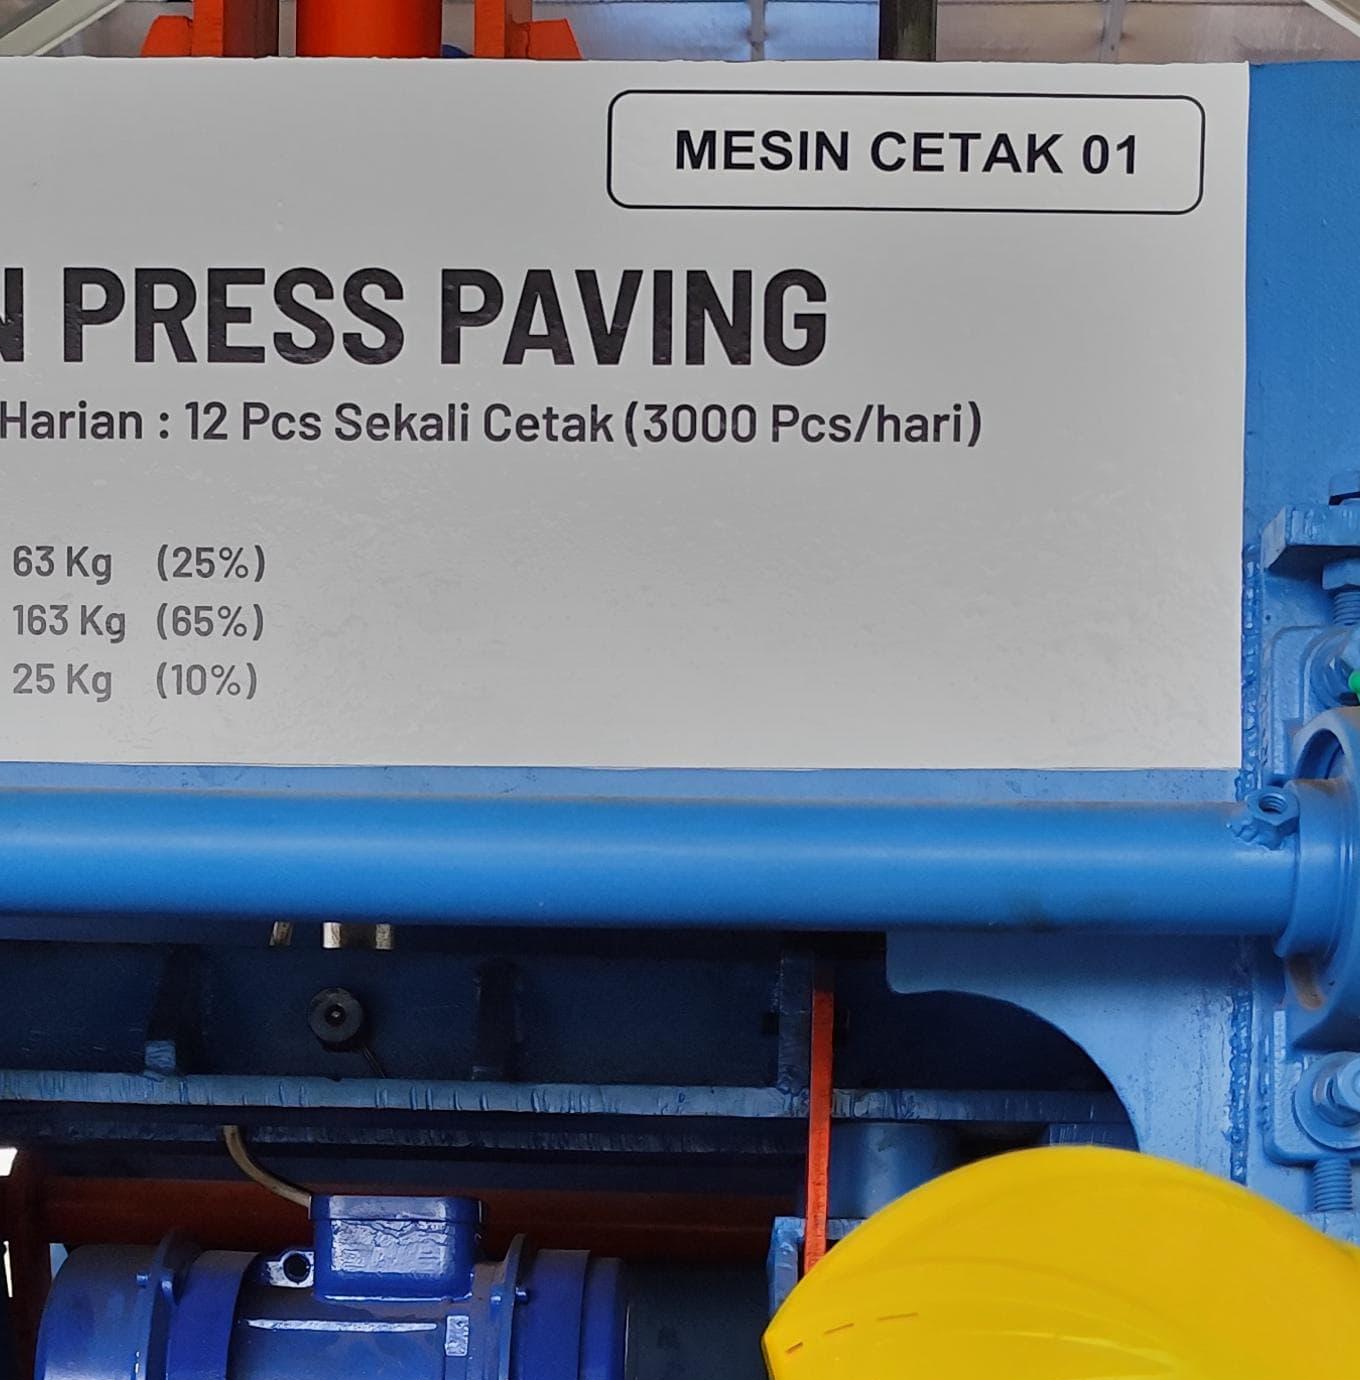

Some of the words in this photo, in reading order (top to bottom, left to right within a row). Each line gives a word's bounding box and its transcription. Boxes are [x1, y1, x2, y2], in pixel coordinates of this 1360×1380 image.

[675, 129, 850, 172] MESIN
[870, 130, 1065, 175] CETAK
[1082, 134, 1137, 175] 01
[62, 266, 405, 366] PRESS
[440, 267, 827, 367] PAVING
[0, 399, 143, 440] Harian
[184, 400, 229, 441] 12
[242, 401, 322, 442] Pcs
[334, 401, 470, 442] Sekali
[483, 402, 615, 443] Cetak
[624, 400, 757, 448] (3000
[771, 400, 982, 448] Pcs/hari)
[13, 544, 55, 577] 63
[66, 545, 112, 586] Kg
[157, 543, 266, 583] (25%)
[12, 604, 69, 636] 163
[80, 604, 126, 645] Kg
[156, 602, 264, 642] (65%)
[12, 662, 56, 695] 25
[66, 662, 112, 703] Kg
[156, 661, 258, 700] (10%)
